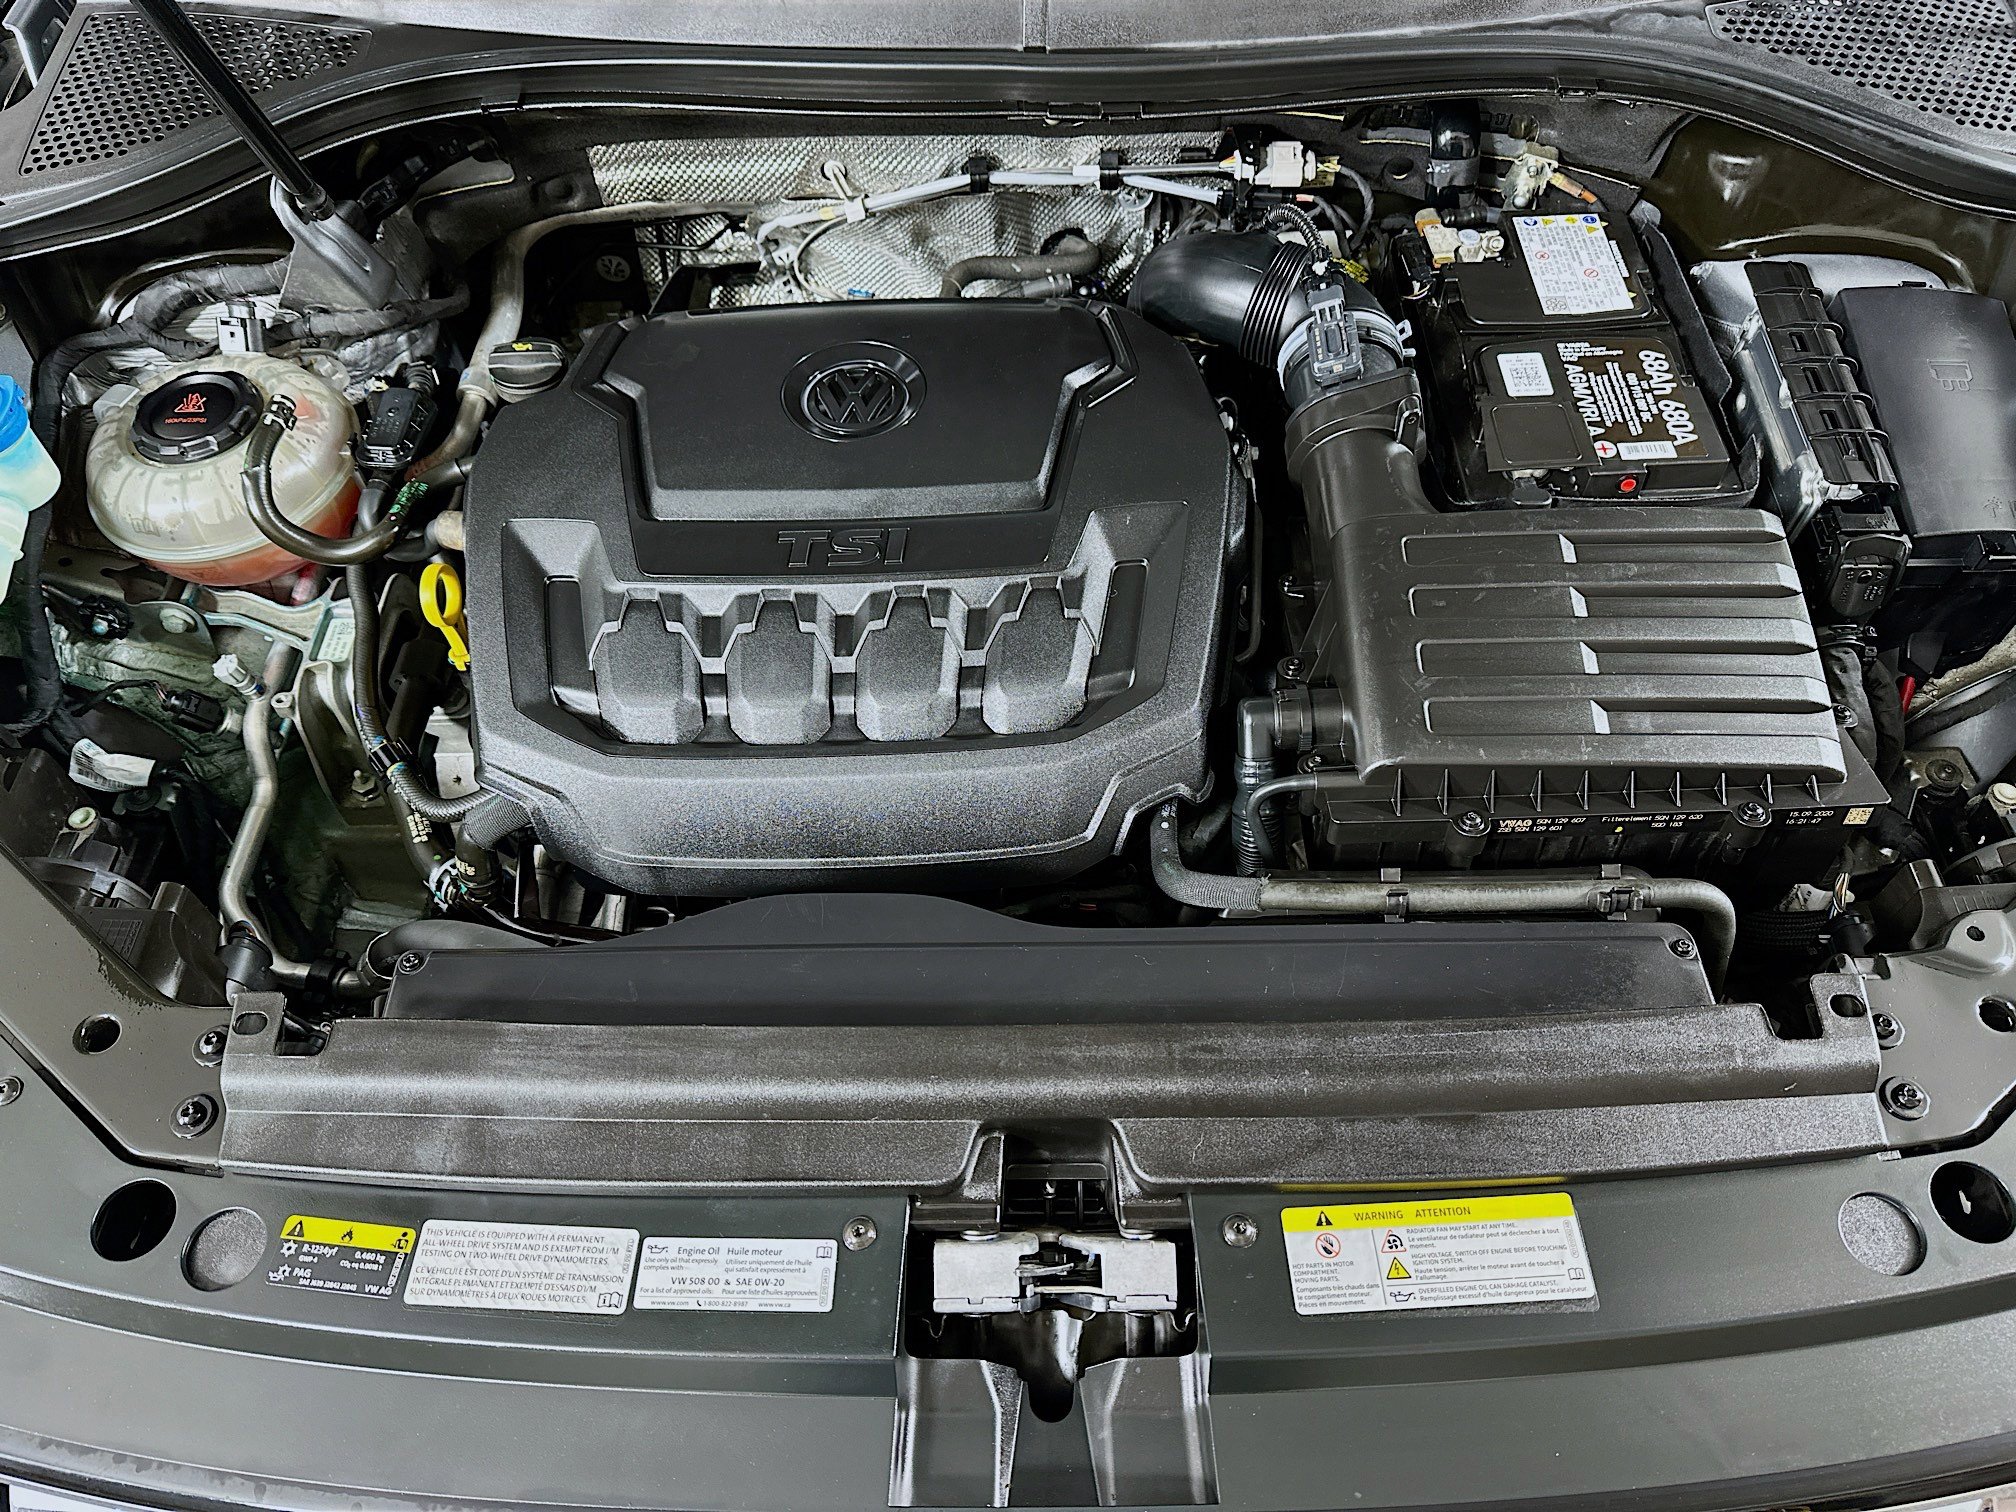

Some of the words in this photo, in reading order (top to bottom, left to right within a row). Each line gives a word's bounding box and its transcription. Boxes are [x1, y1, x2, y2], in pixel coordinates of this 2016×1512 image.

[1639, 350, 1677, 395] 68Ah
[1658, 400, 1698, 446] 680A
[778, 527, 910, 567] TSI
[1354, 1210, 1404, 1221] WARNING
[1415, 1207, 1471, 1218] ATTENTION
[426, 1228, 443, 1236] THIS
[445, 1229, 476, 1238] VEHICLE
[487, 1231, 526, 1239] EQUIPPED
[527, 1233, 548, 1241] WITH
[557, 1235, 605, 1243] PERMANENT
[422, 1239, 465, 1248] ALL-WHEEL
[467, 1241, 491, 1249] DRIVE
[492, 1242, 521, 1250] SYSTEM
[522, 1243, 540, 1251] AND
[551, 1245, 580, 1253] EXEMPT
[582, 1246, 604, 1254] FROM
[678, 1246, 706, 1257] Engine
[707, 1247, 720, 1255] Oil
[727, 1247, 749, 1256] Huile
[751, 1248, 783, 1256] moteur
[421, 1249, 452, 1258] TESTING
[468, 1251, 517, 1260] TWO-WHEEL
[292, 1267, 312, 1278] PAG
[415, 1266, 425, 1274] CE
[479, 1268, 499, 1277] DOTÉ
[568, 1274, 625, 1283] TRANSMISSION
[453, 1279, 499, 1288] PERMANENT
[671, 1276, 687, 1285] VW
[689, 1277, 706, 1285] 508
[708, 1278, 720, 1286] 00
[736, 1278, 753, 1286] SAE
[754, 1278, 785, 1287] 0W-20
[1503, 1281, 1528, 1289] DAMAGE
[364, 1284, 379, 1294] VW
[380, 1287, 392, 1295] AG
[498, 1292, 519, 1300] DEUX
[521, 1293, 546, 1301] ROUES
